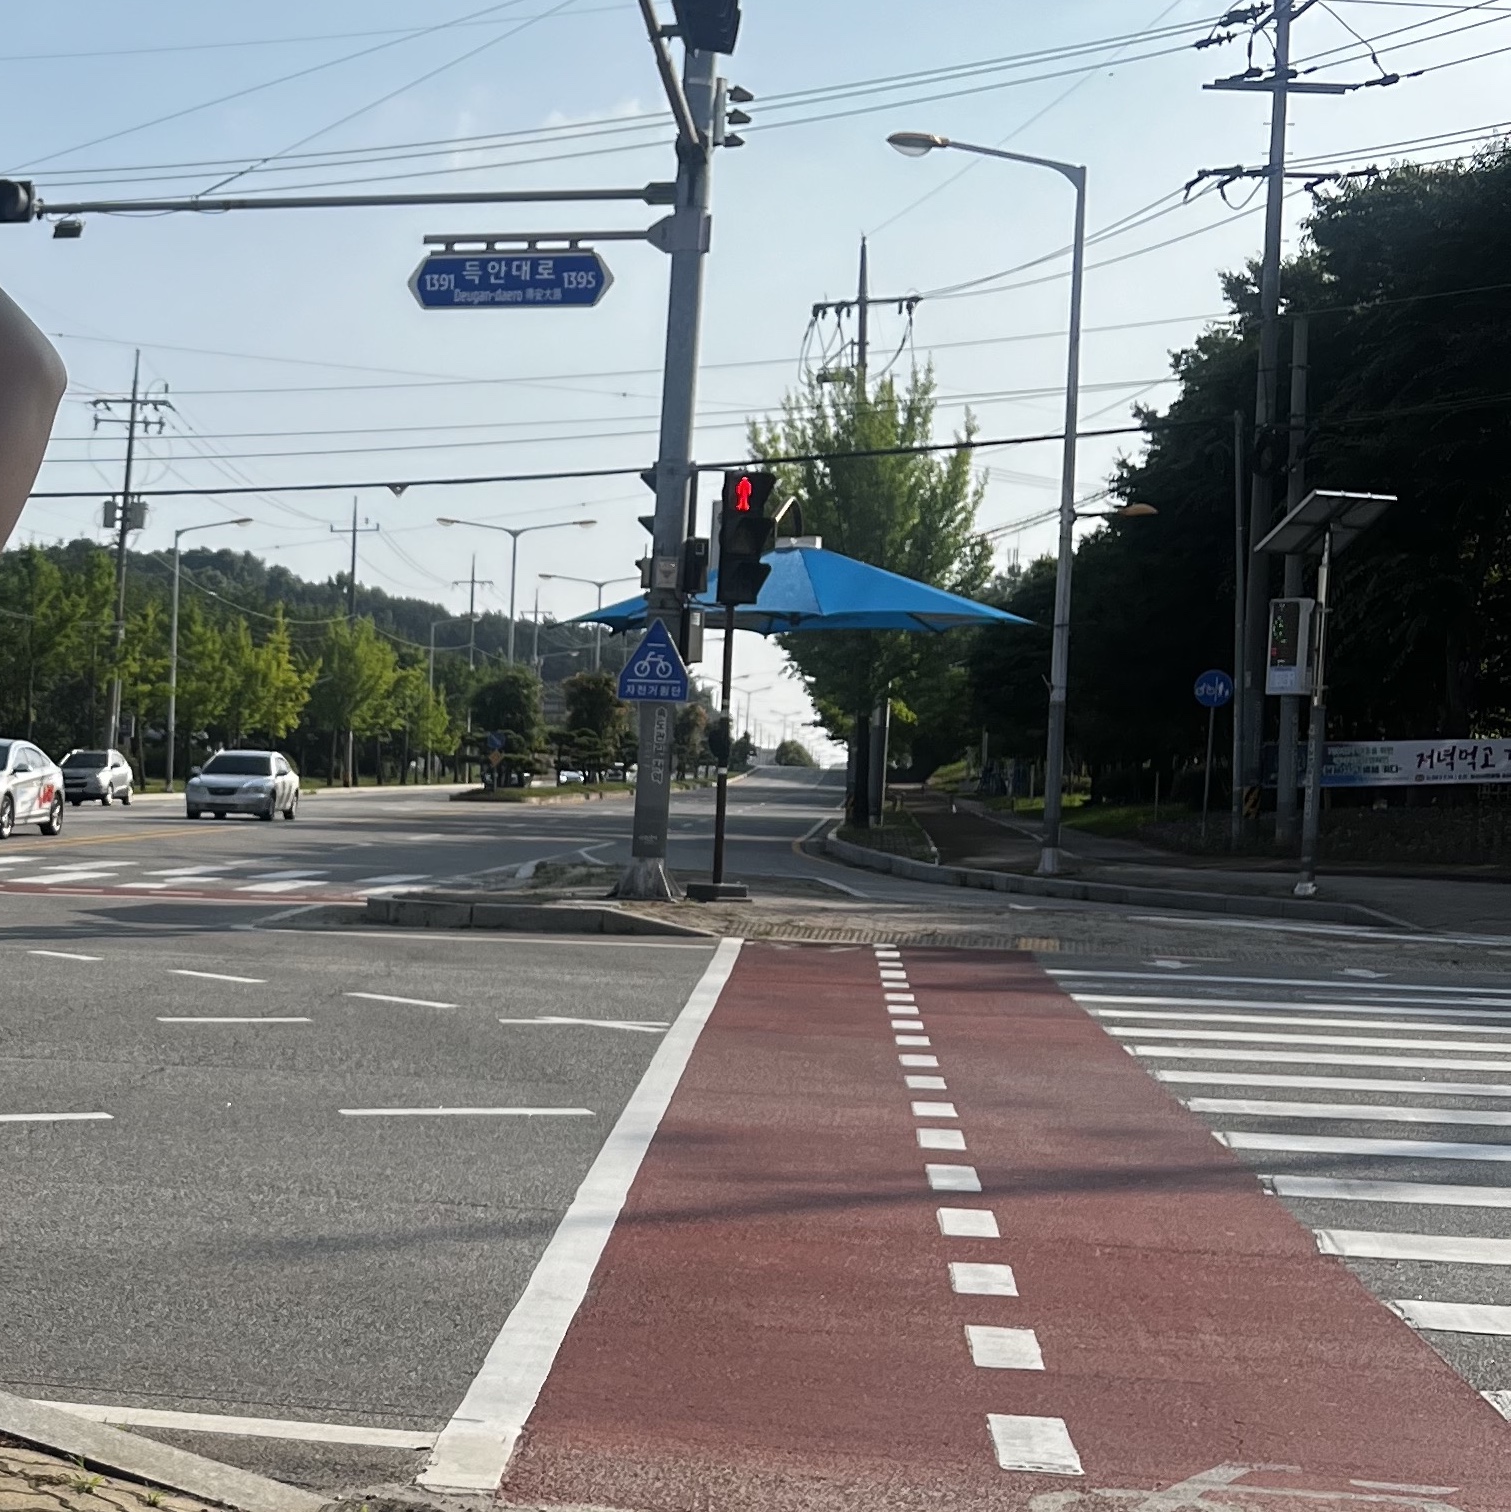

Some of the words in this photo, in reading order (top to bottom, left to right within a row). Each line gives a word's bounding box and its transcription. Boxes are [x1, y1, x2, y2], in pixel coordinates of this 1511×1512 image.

[462, 259, 556, 285] 득안대로
[562, 271, 597, 289] 1395
[424, 273, 456, 291] 1391
[453, 288, 524, 304] Deugan-daero
[1416, 745, 1497, 772] 저녁먹고
